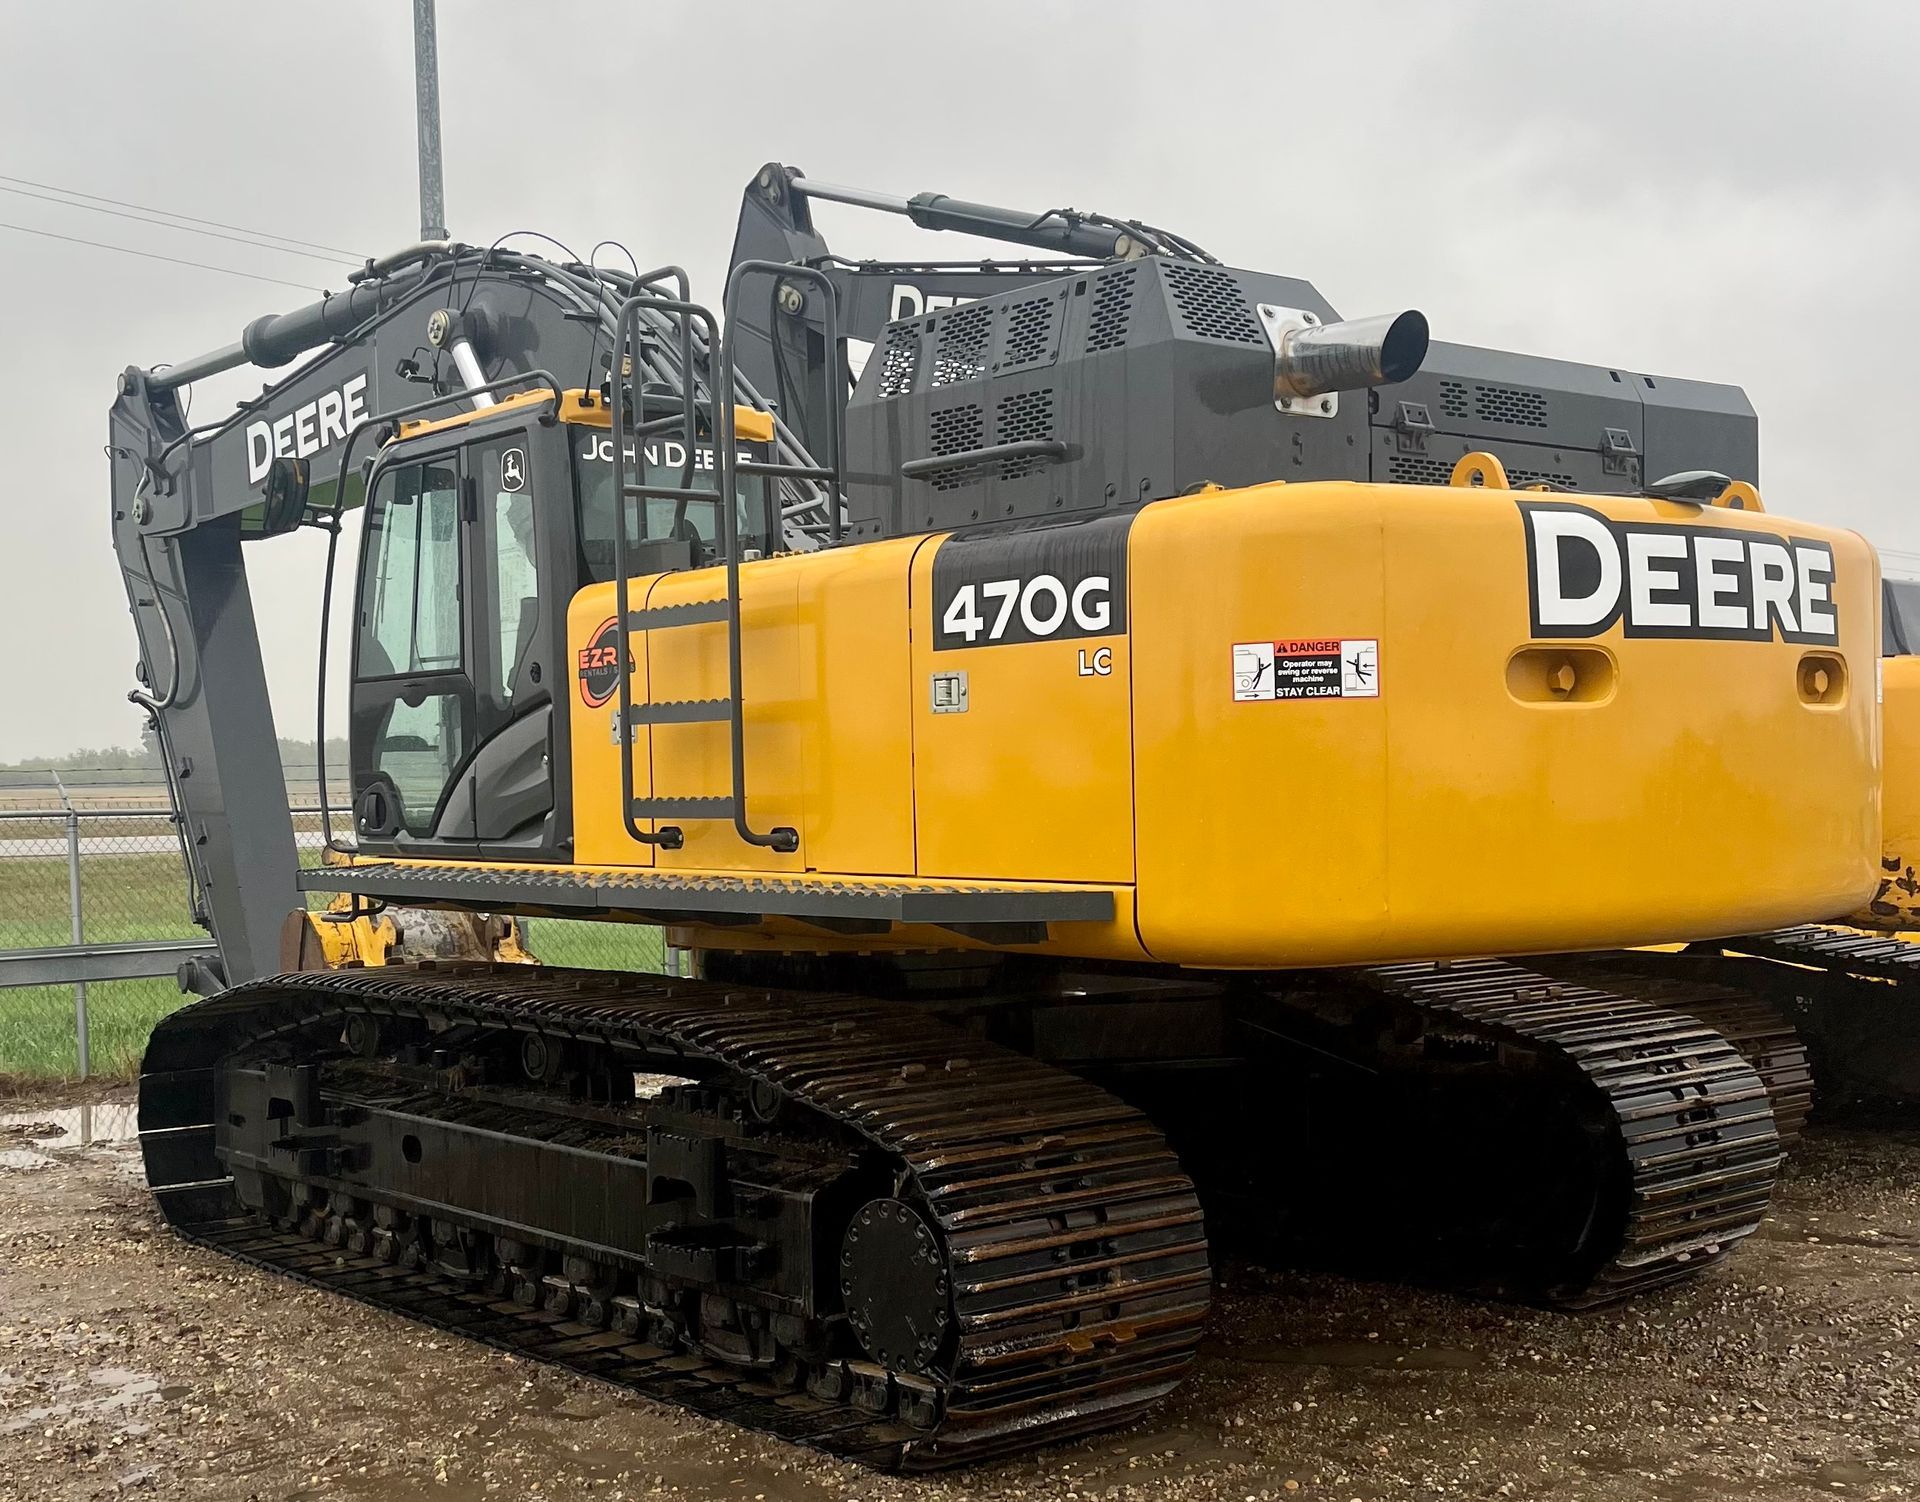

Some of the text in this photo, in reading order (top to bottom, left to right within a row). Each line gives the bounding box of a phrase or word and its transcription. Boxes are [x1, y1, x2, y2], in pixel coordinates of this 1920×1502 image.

[246, 373, 369, 485] DEERE
[582, 434, 659, 466] JOHN
[1529, 510, 1836, 635] DEERE
[943, 574, 1110, 642] 470G
[1289, 641, 1340, 653] DANGER
[579, 647, 635, 669] EZR
[1078, 647, 1112, 676] LC
[1282, 660, 1333, 669] Operator may
[580, 668, 608, 678] RENTALS
[1278, 669, 1300, 677] swing
[1311, 667, 1338, 675] reverse
[1292, 675, 1324, 683] machine
[1276, 686, 1341, 697] STAY CLEAR
